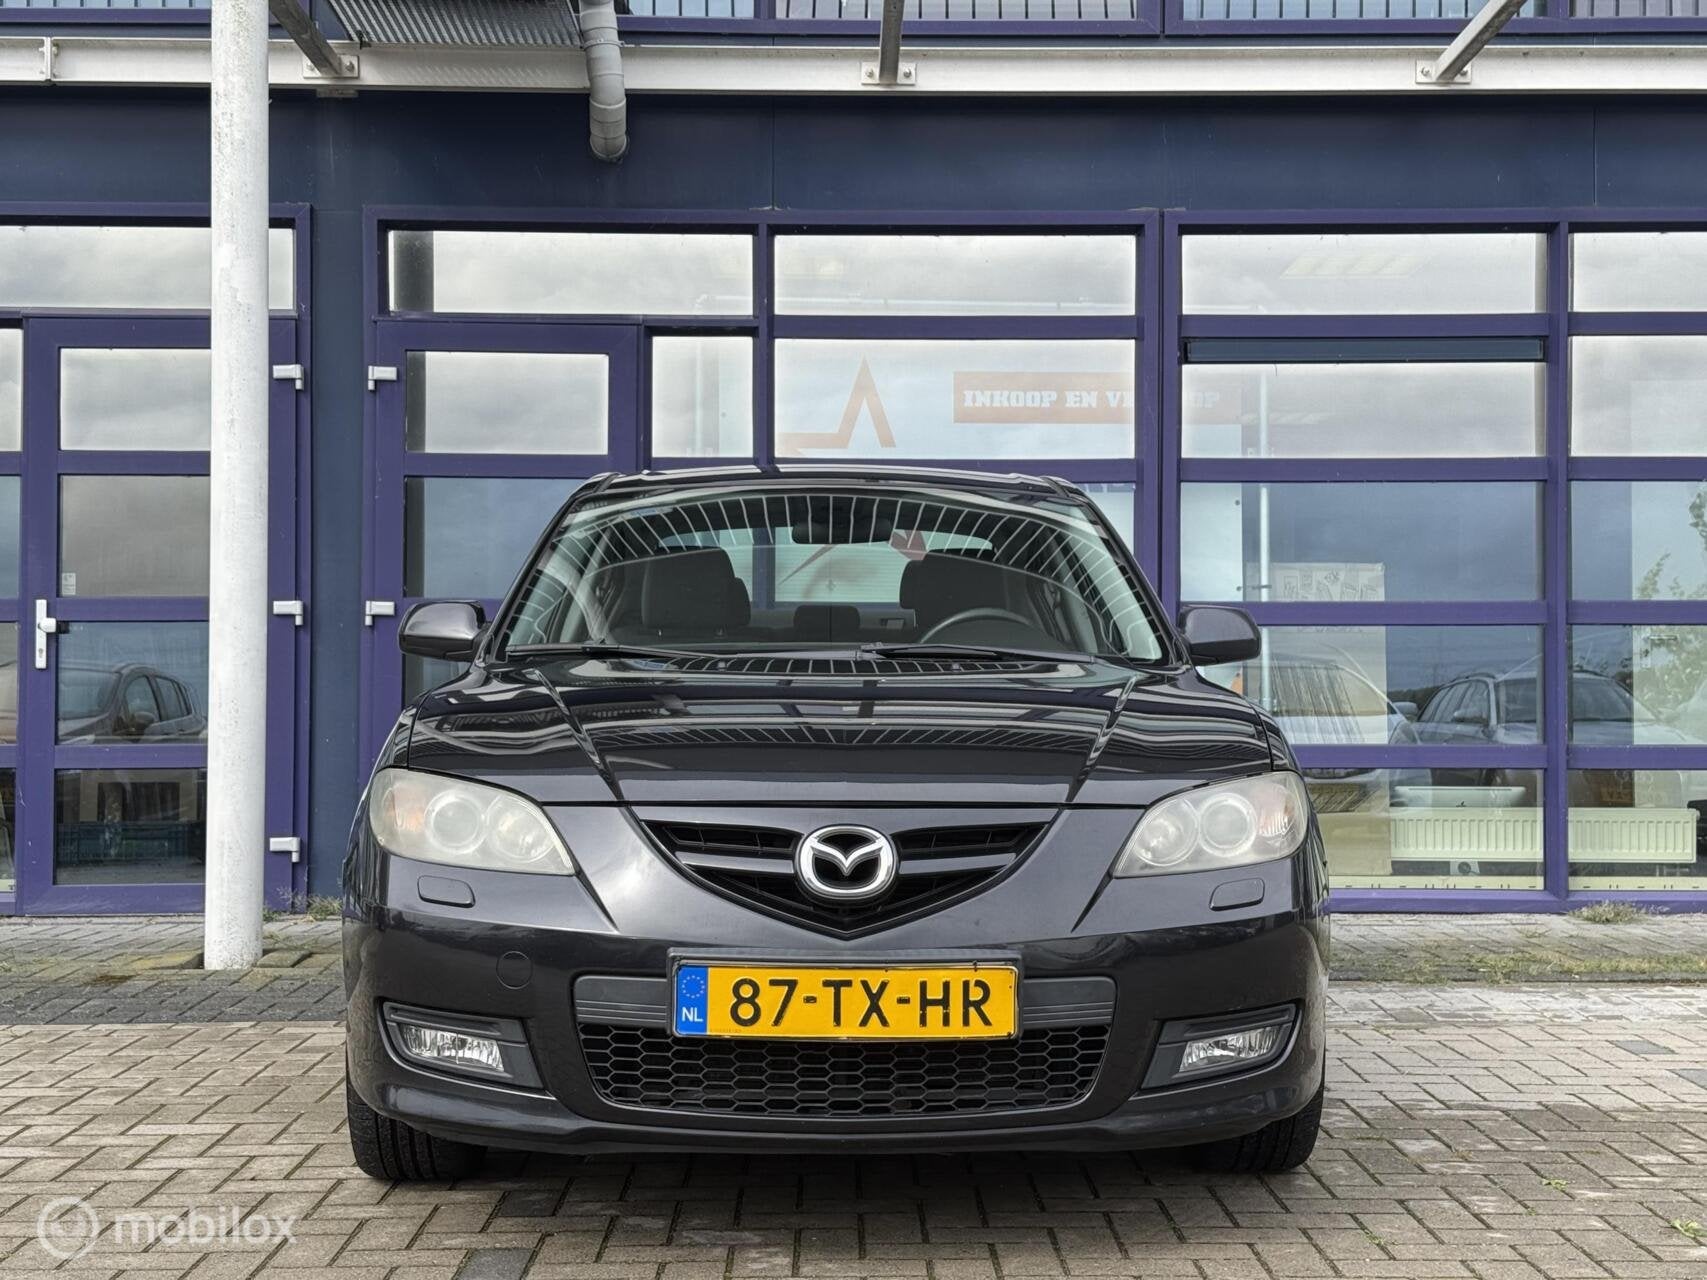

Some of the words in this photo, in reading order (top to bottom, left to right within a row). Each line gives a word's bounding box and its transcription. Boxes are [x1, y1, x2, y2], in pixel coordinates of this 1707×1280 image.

[963, 390, 1058, 408] INKOOP
[1064, 390, 1098, 408] EN
[730, 977, 993, 1027] 87-TX-HR
[681, 1006, 704, 1023] NL
